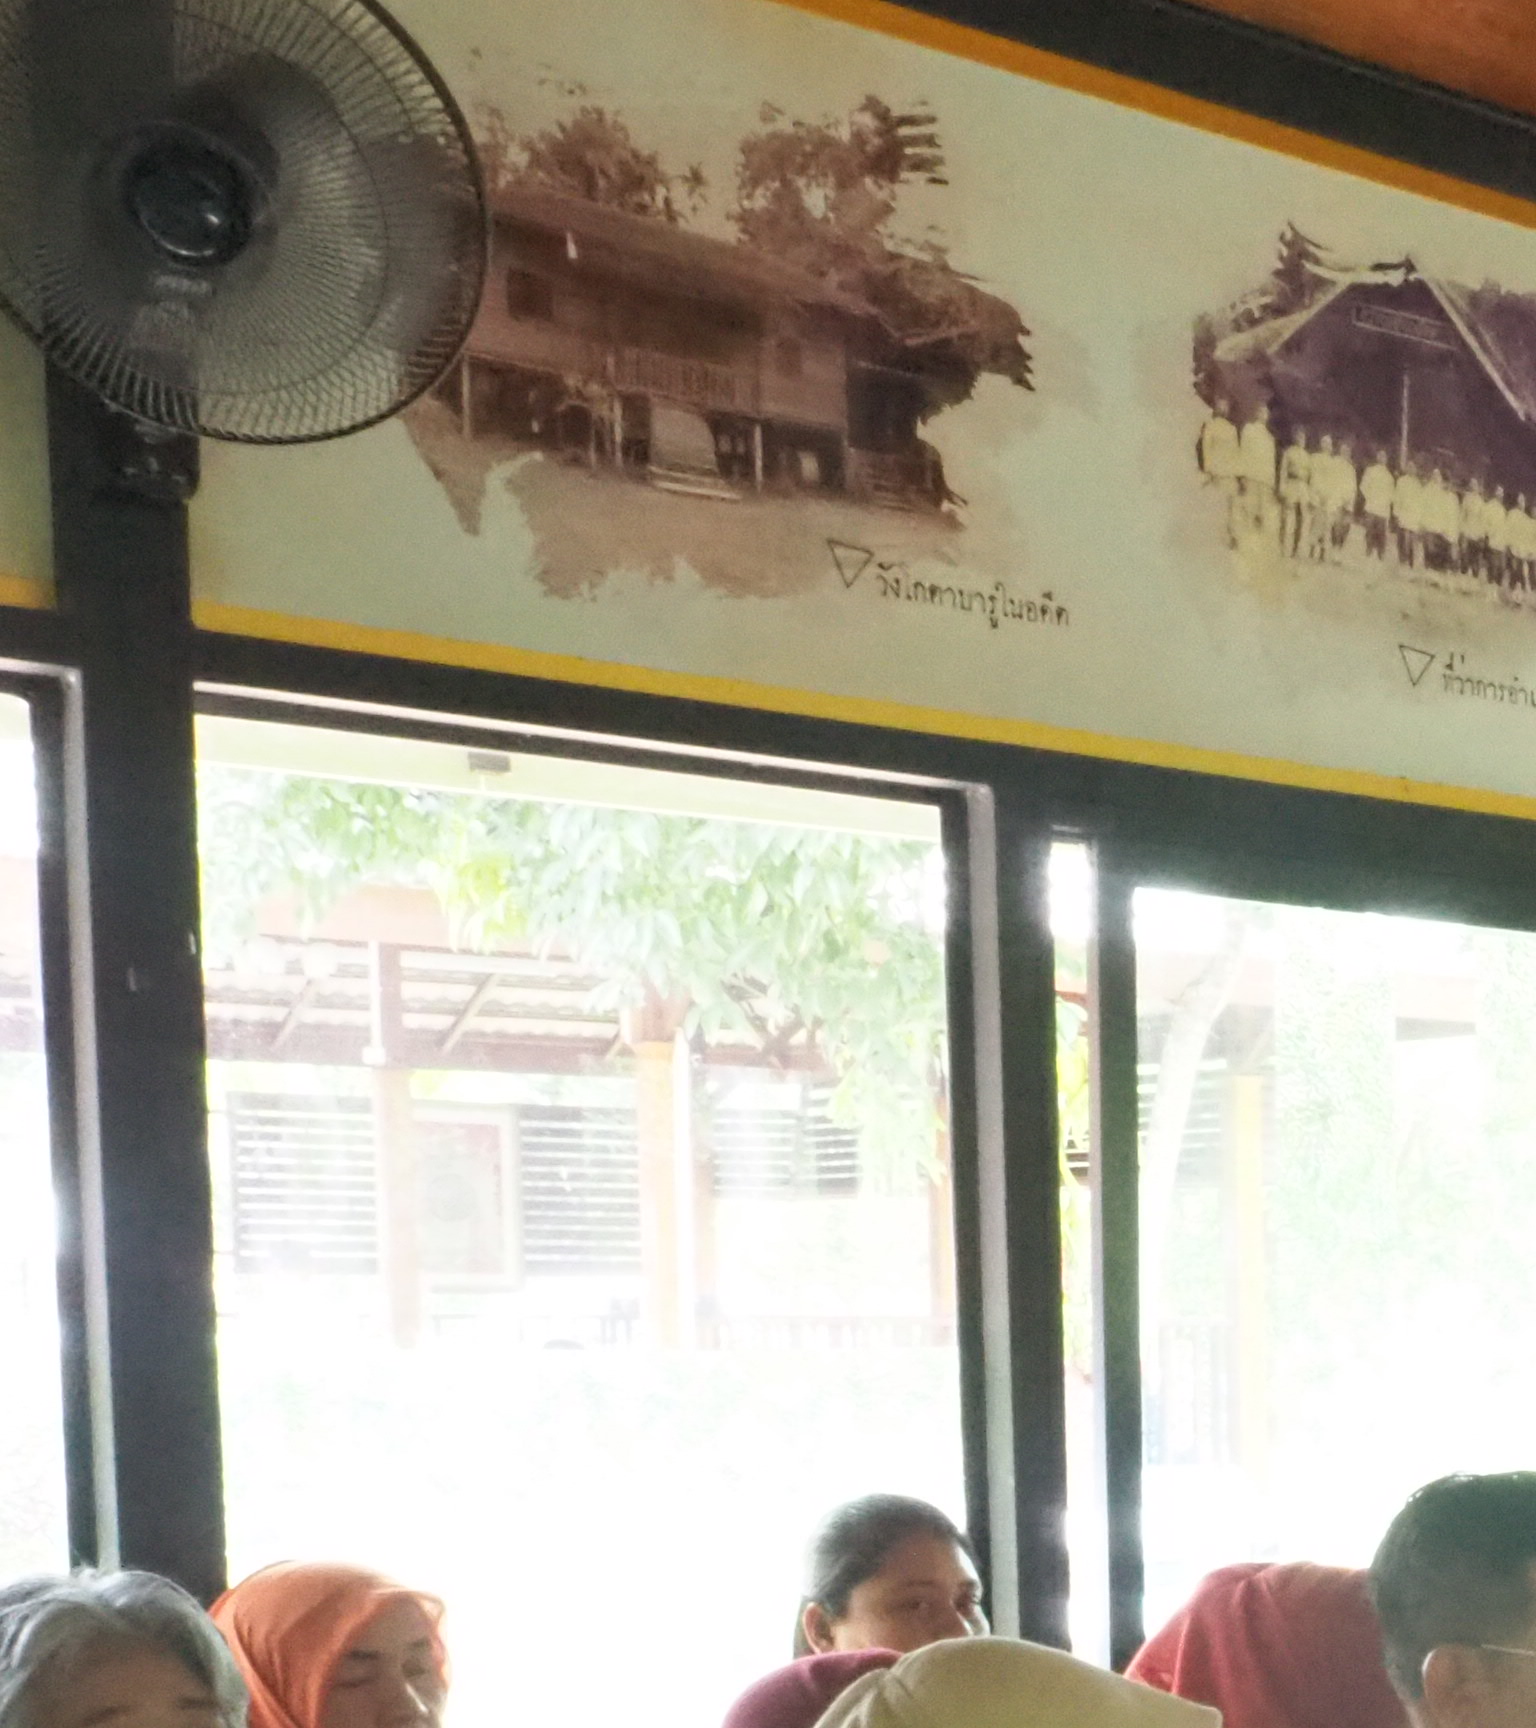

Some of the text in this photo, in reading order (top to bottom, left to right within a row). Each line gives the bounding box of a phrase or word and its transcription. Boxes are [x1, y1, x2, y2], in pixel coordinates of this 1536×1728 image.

[877, 561, 1069, 629] วังโกตาบารูในอดีต
